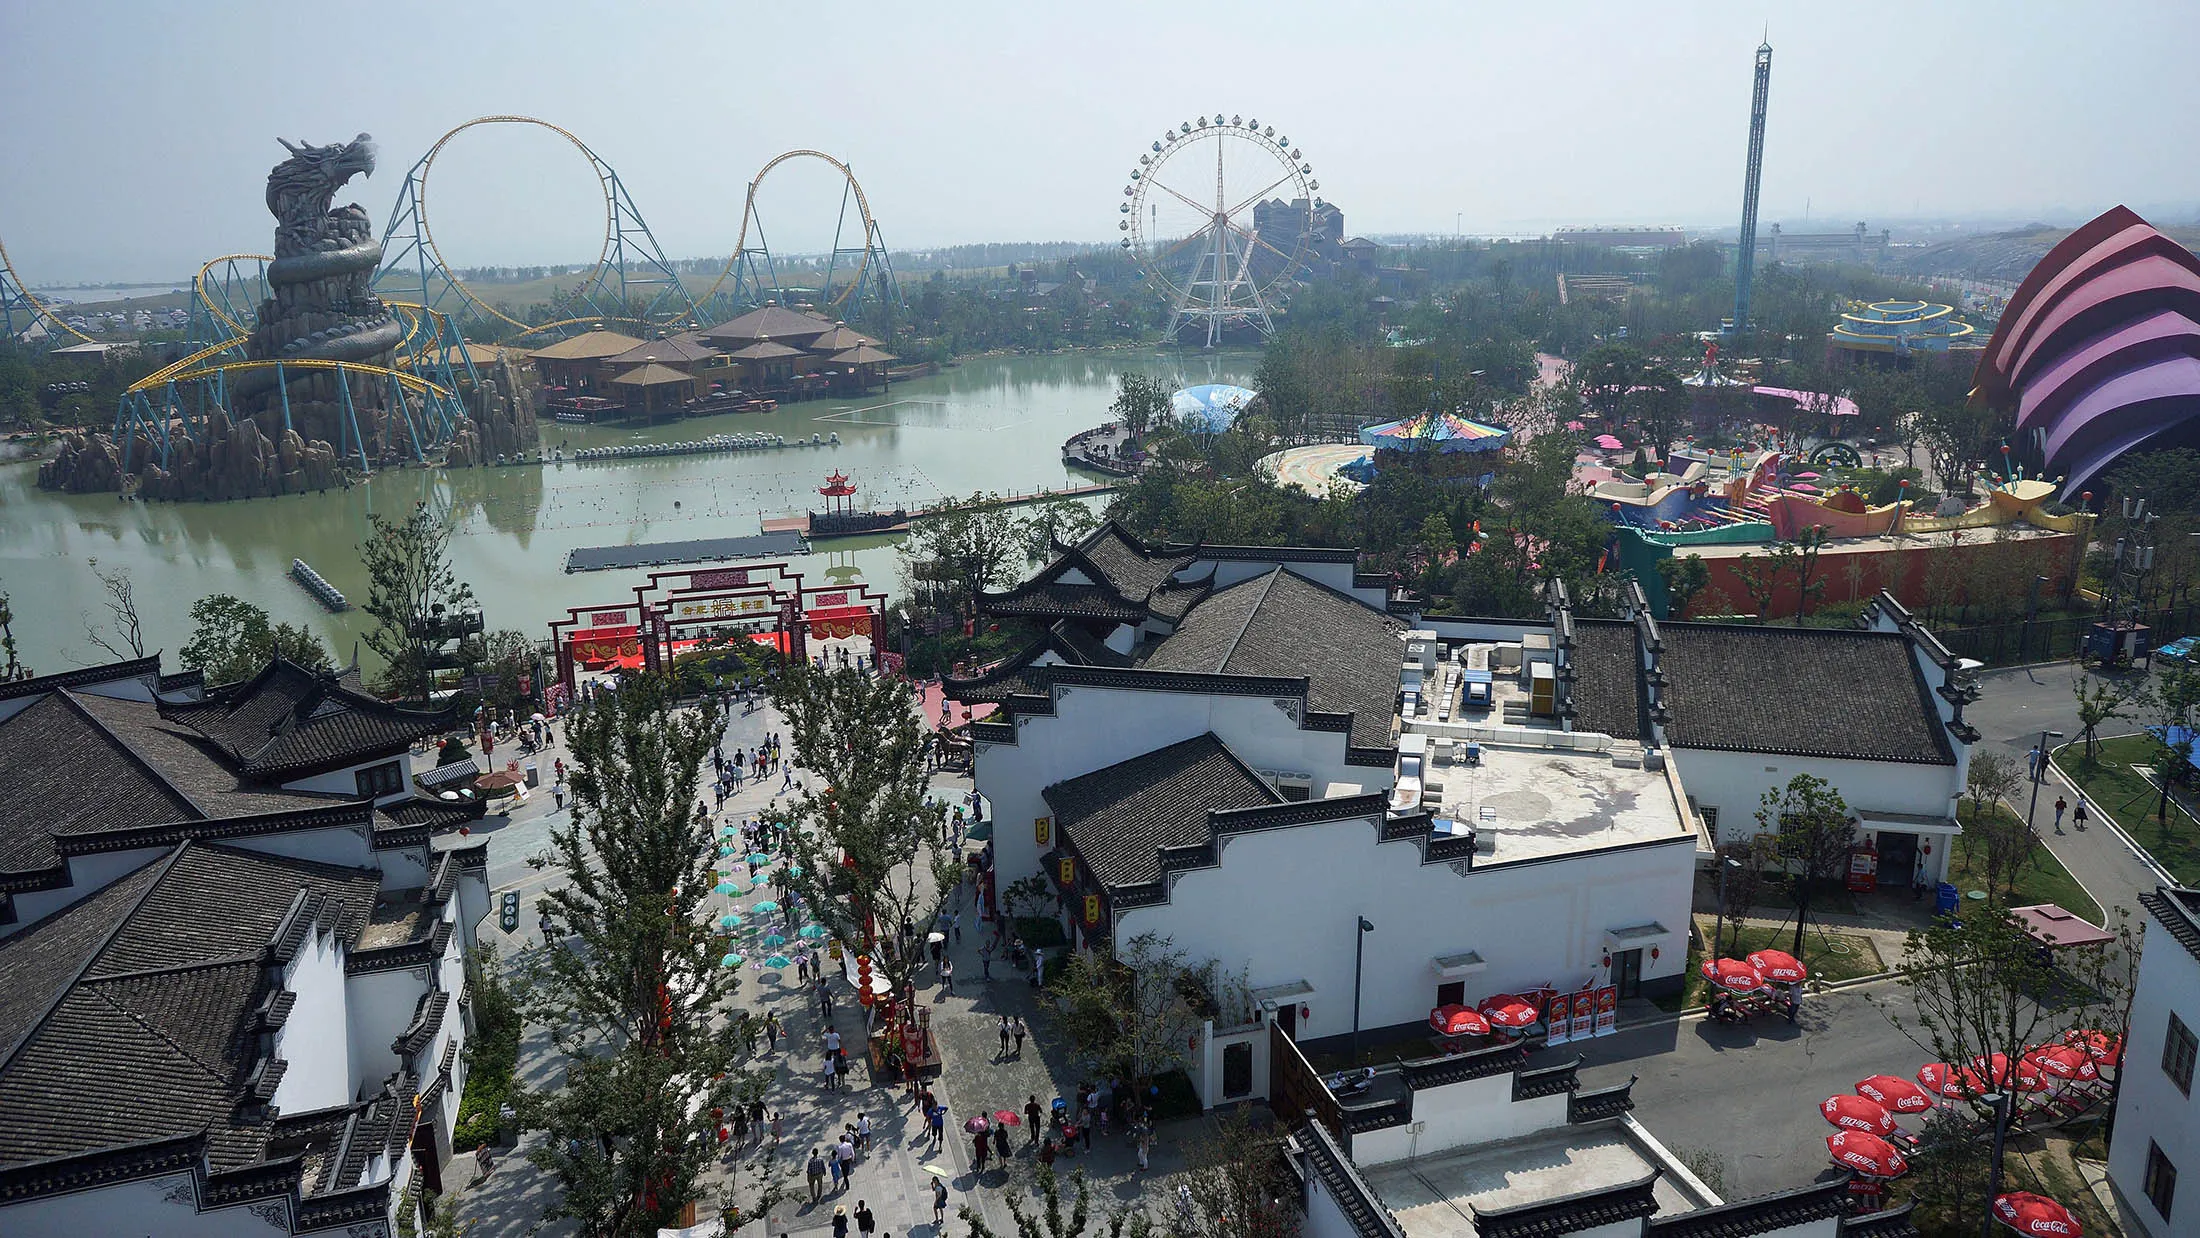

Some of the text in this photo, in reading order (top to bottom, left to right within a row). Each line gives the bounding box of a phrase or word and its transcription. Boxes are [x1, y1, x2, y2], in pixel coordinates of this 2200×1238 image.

[1725, 975, 1752, 986] Coca-Cola
[1453, 1022, 1481, 1032] Coca-Cola
[1897, 1095, 1925, 1109] Coca-Cola
[2031, 1218, 2070, 1235] Coca-Cola
